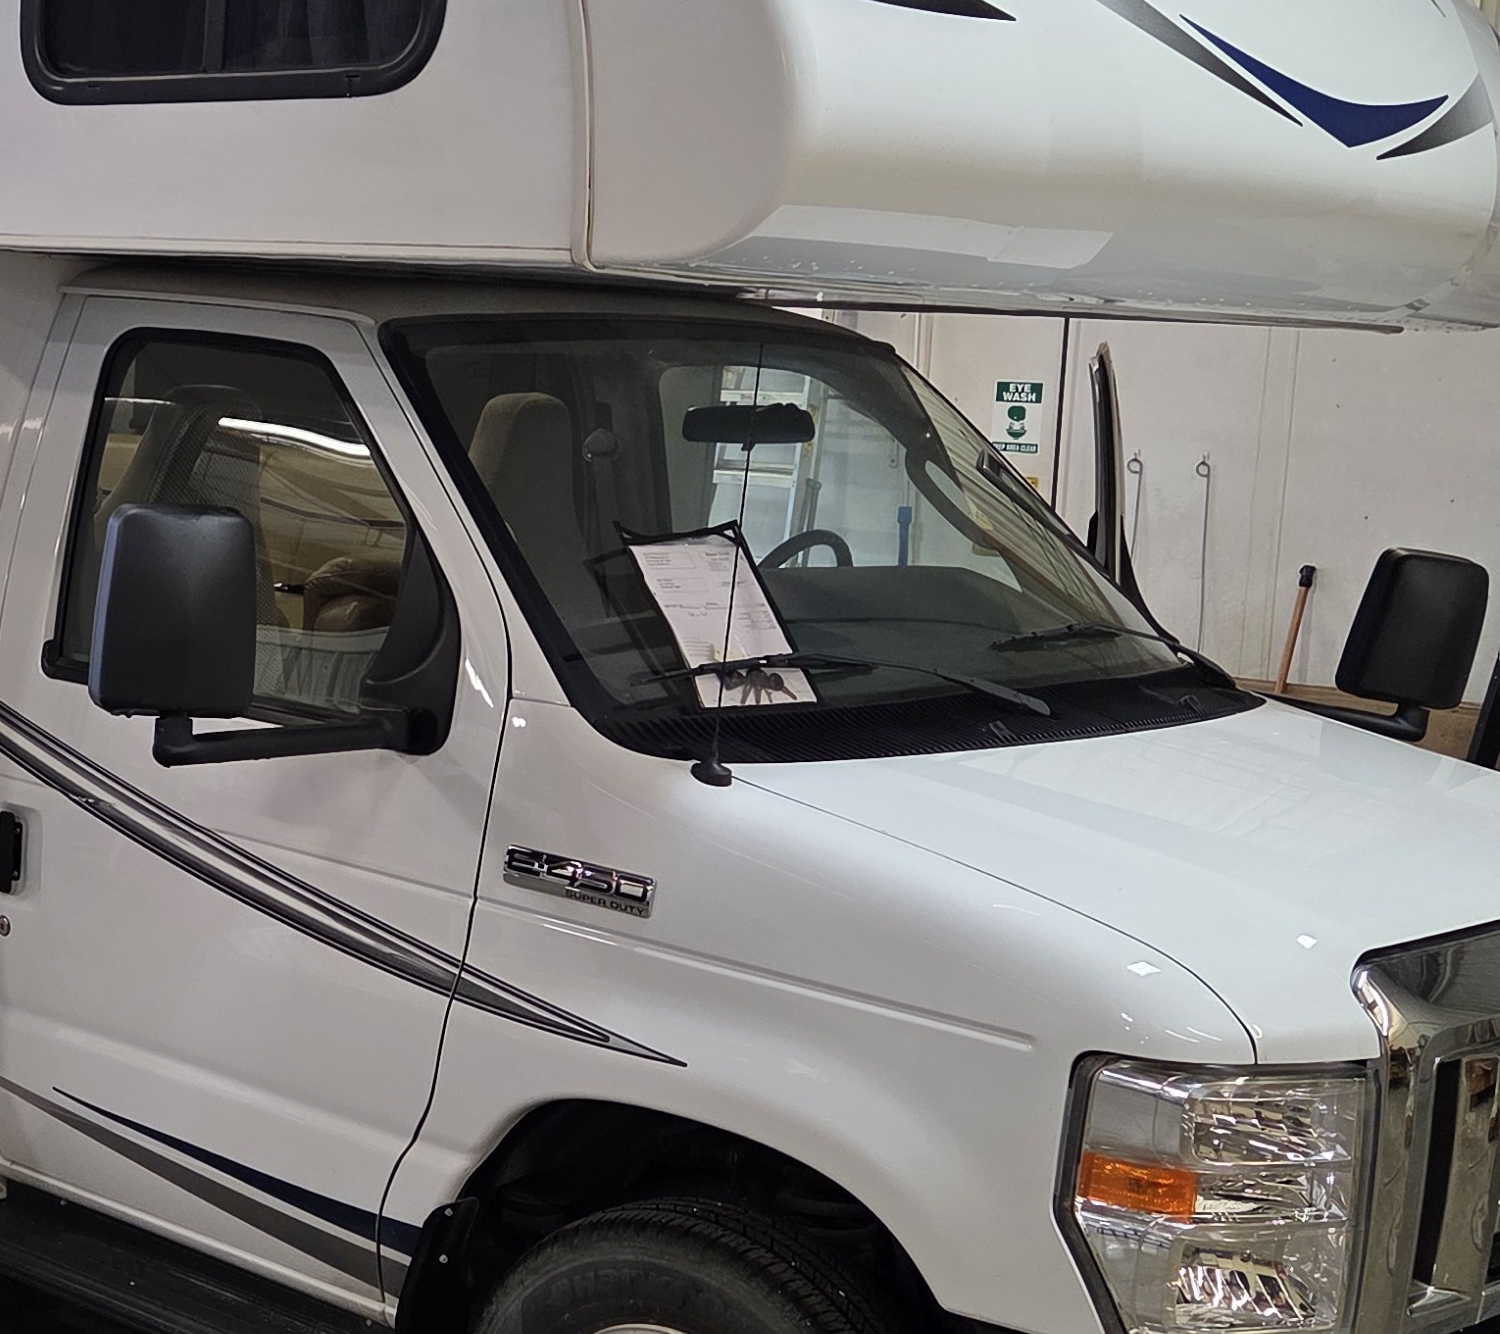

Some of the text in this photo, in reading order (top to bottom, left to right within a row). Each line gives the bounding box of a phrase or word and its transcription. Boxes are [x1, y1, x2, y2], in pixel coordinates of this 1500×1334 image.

[1009, 383, 1031, 393] EYE
[1003, 392, 1036, 402] WASH
[564, 889, 646, 916] SUPER DUTY
